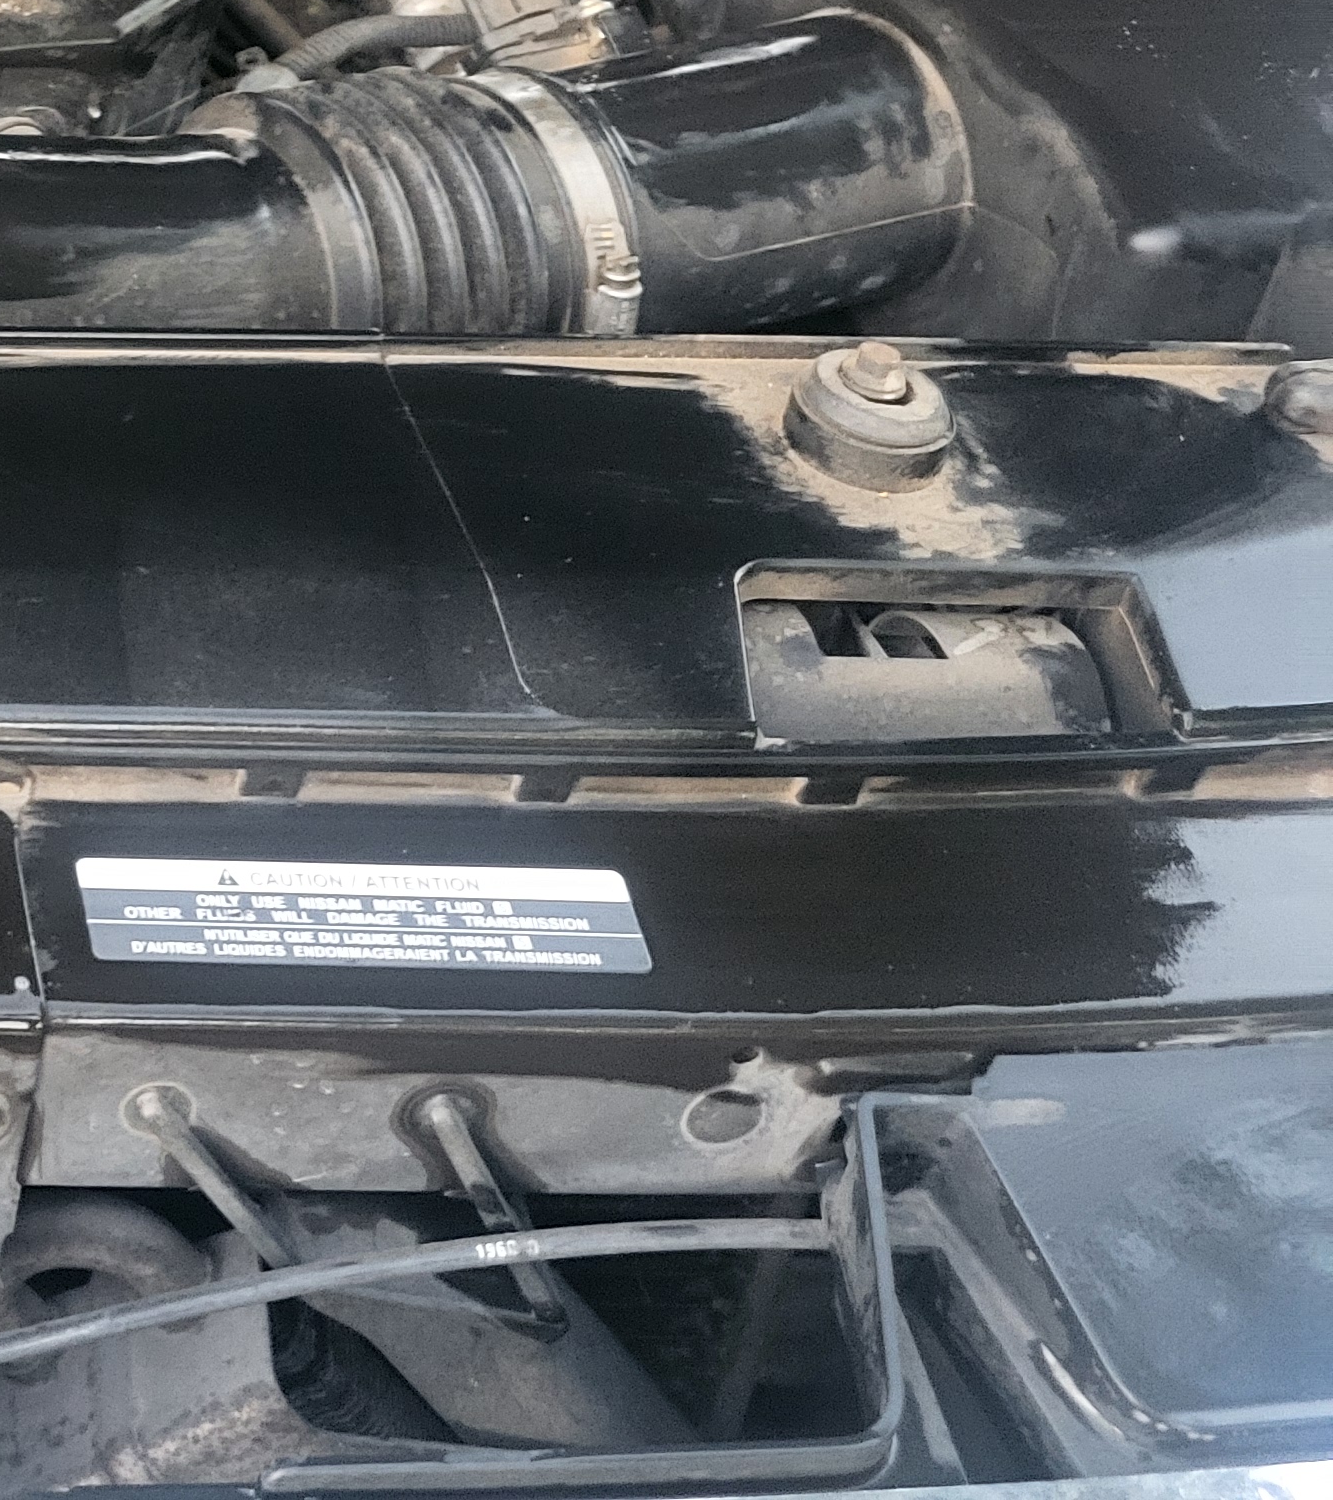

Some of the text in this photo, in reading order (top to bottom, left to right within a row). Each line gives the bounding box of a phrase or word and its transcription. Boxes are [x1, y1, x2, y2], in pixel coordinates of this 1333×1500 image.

[249, 871, 343, 888] CAUTION
[365, 875, 480, 892] ATTENTION
[196, 894, 239, 908] ONLY
[251, 896, 286, 909] USE
[297, 897, 363, 911] NISSAN
[372, 899, 425, 912] MATIC
[435, 901, 484, 915] FLUID
[124, 906, 182, 920] OTHER
[271, 910, 314, 923] WILL
[327, 912, 400, 925] DAMAGE
[412, 914, 449, 927] THE
[462, 915, 590, 931] TRANSMISSION
[283, 930, 316, 943] QUE
[318, 932, 340, 943] DU
[342, 932, 401, 946] LIQUIDE
[402, 934, 447, 947] MATIC
[450, 935, 507, 948] NISSAN
[131, 940, 602, 966] D'AUTRES LIQUIDES ENDOMMAGERAIENT LA TRANSMISSION
